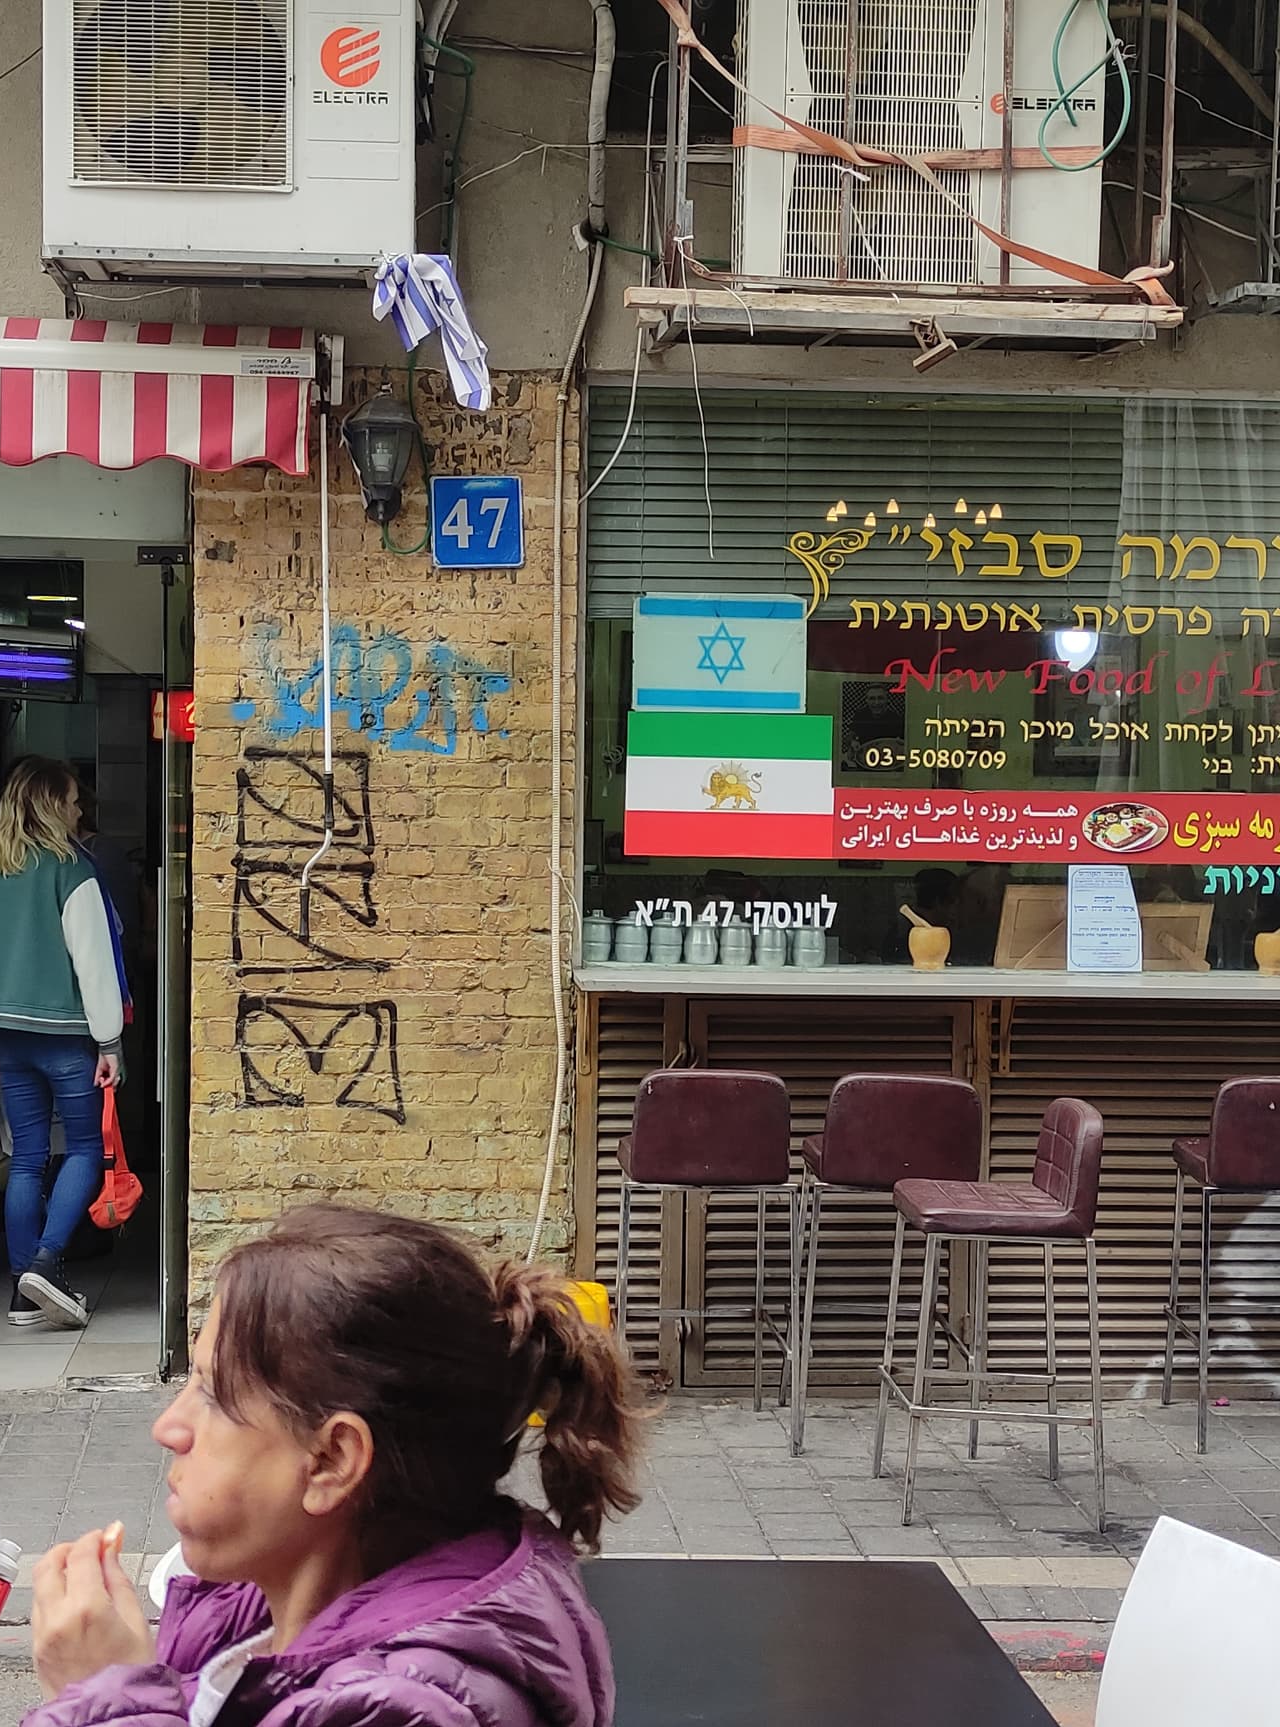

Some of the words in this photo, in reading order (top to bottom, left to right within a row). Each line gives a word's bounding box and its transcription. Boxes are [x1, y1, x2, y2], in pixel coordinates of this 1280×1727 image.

[313, 91, 389, 104] ELECTRA
[441, 498, 509, 549] 47
[848, 599, 1043, 633] אוטנתית
[1072, 604, 1213, 636] פרסית
[884, 647, 1007, 696] New
[1025, 650, 1169, 697] Food
[1175, 651, 1233, 715] of
[924, 718, 1006, 739] הביתה
[1020, 719, 1075, 742] מוכן
[1089, 717, 1149, 741] אוכל
[1164, 720, 1233, 746] לקחת
[865, 748, 1007, 770] 03-5080709
[1202, 757, 1232, 775] בני
[914, 797, 957, 822] صرف
[963, 799, 974, 821] با
[980, 804, 1018, 822] روزه
[841, 824, 891, 849] ایرانی
[1068, 834, 1078, 850] و
[1173, 811, 1240, 852] سبزی
[635, 898, 692, 927] ת"א
[702, 900, 734, 927] 47
[744, 894, 838, 936] לוינסקי
